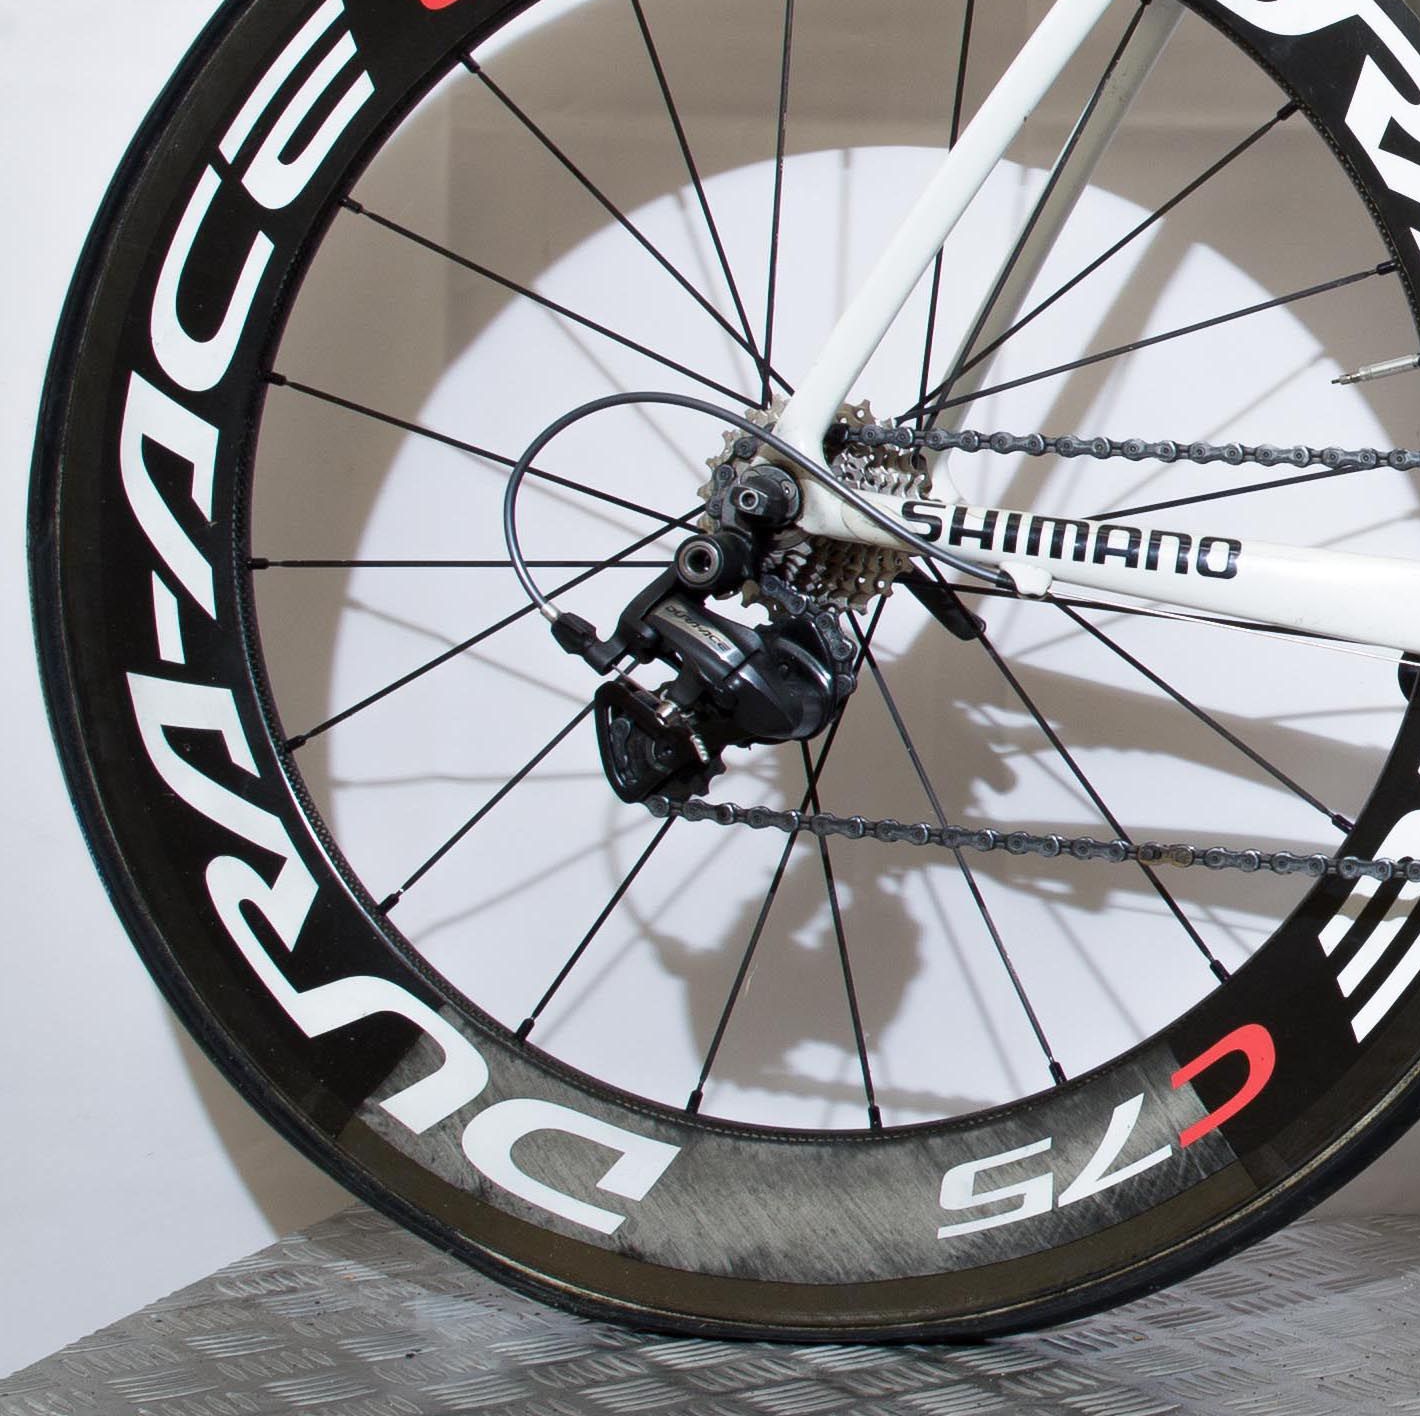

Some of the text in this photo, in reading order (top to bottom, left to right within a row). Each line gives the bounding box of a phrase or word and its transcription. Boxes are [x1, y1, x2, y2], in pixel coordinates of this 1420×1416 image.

[901, 500, 1243, 581] SHIMANO
[664, 604, 732, 653] DURA-ACE
[937, 1022, 1277, 1241] C75
